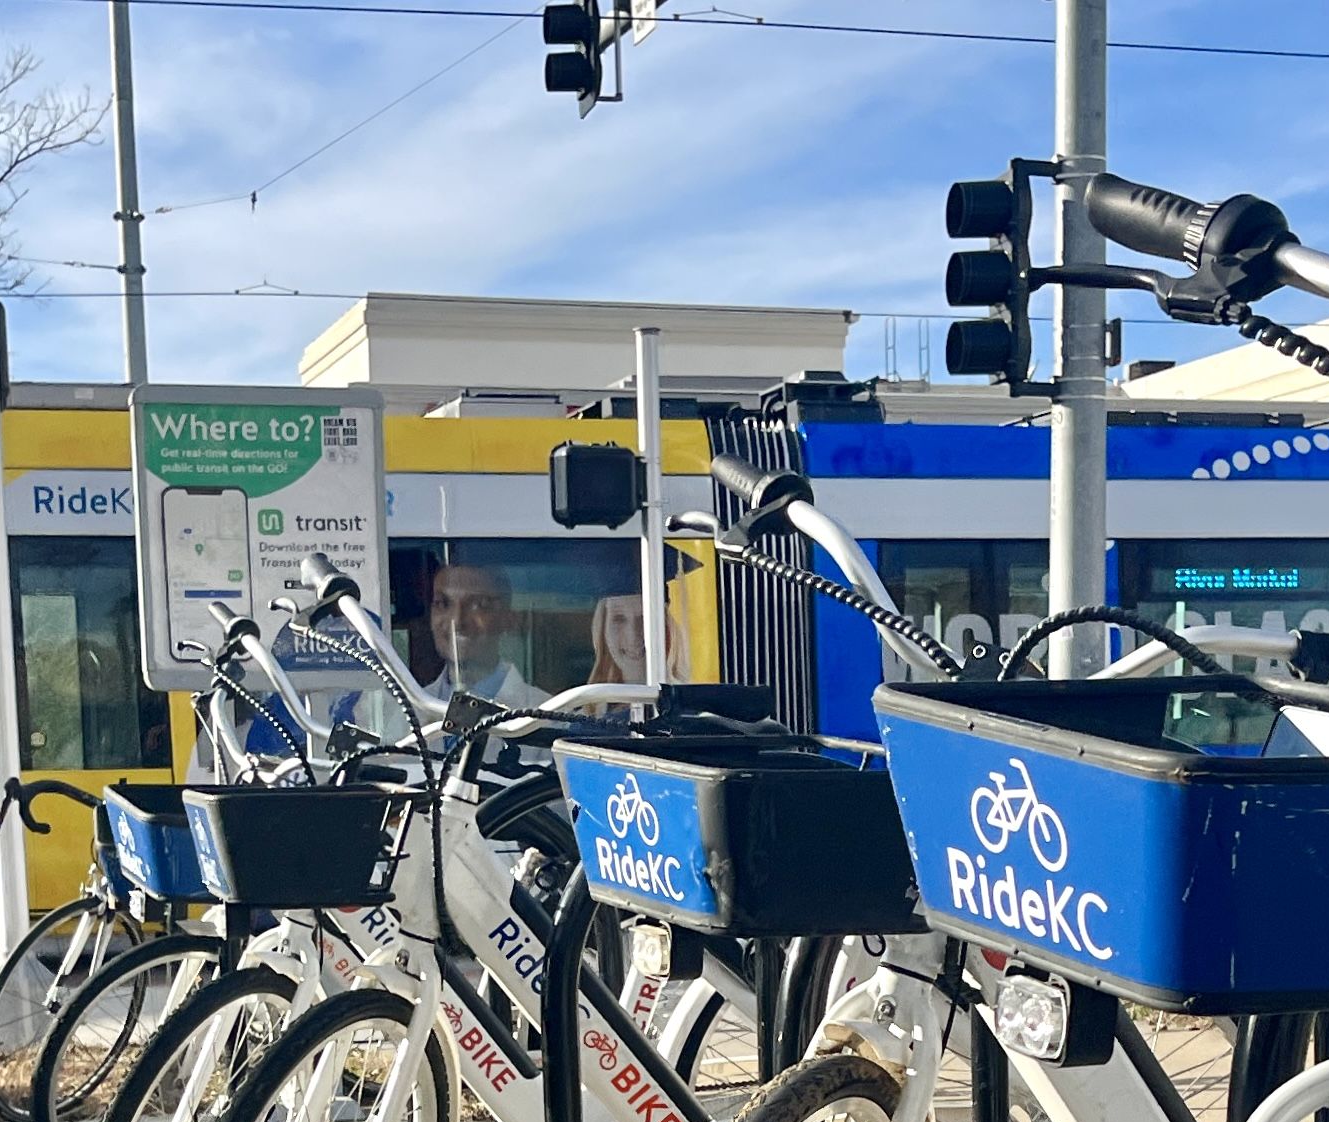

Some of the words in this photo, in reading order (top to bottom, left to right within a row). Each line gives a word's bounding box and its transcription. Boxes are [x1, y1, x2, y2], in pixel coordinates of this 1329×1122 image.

[151, 413, 259, 441] Where
[269, 415, 315, 442] to?
[160, 447, 179, 458] Get
[182, 448, 228, 458] real-time
[230, 448, 282, 459] directions
[283, 448, 299, 458] for
[161, 462, 193, 474] public
[196, 463, 229, 473] transit
[231, 465, 246, 473] on
[247, 463, 264, 473] the
[33, 485, 134, 515] RideK
[295, 514, 364, 531] transit
[259, 542, 318, 553] Download
[321, 542, 339, 552] the
[343, 542, 366, 552] free
[595, 836, 685, 902] RideKC
[946, 846, 1114, 961] RideKC
[458, 1026, 517, 1092] BIKE
